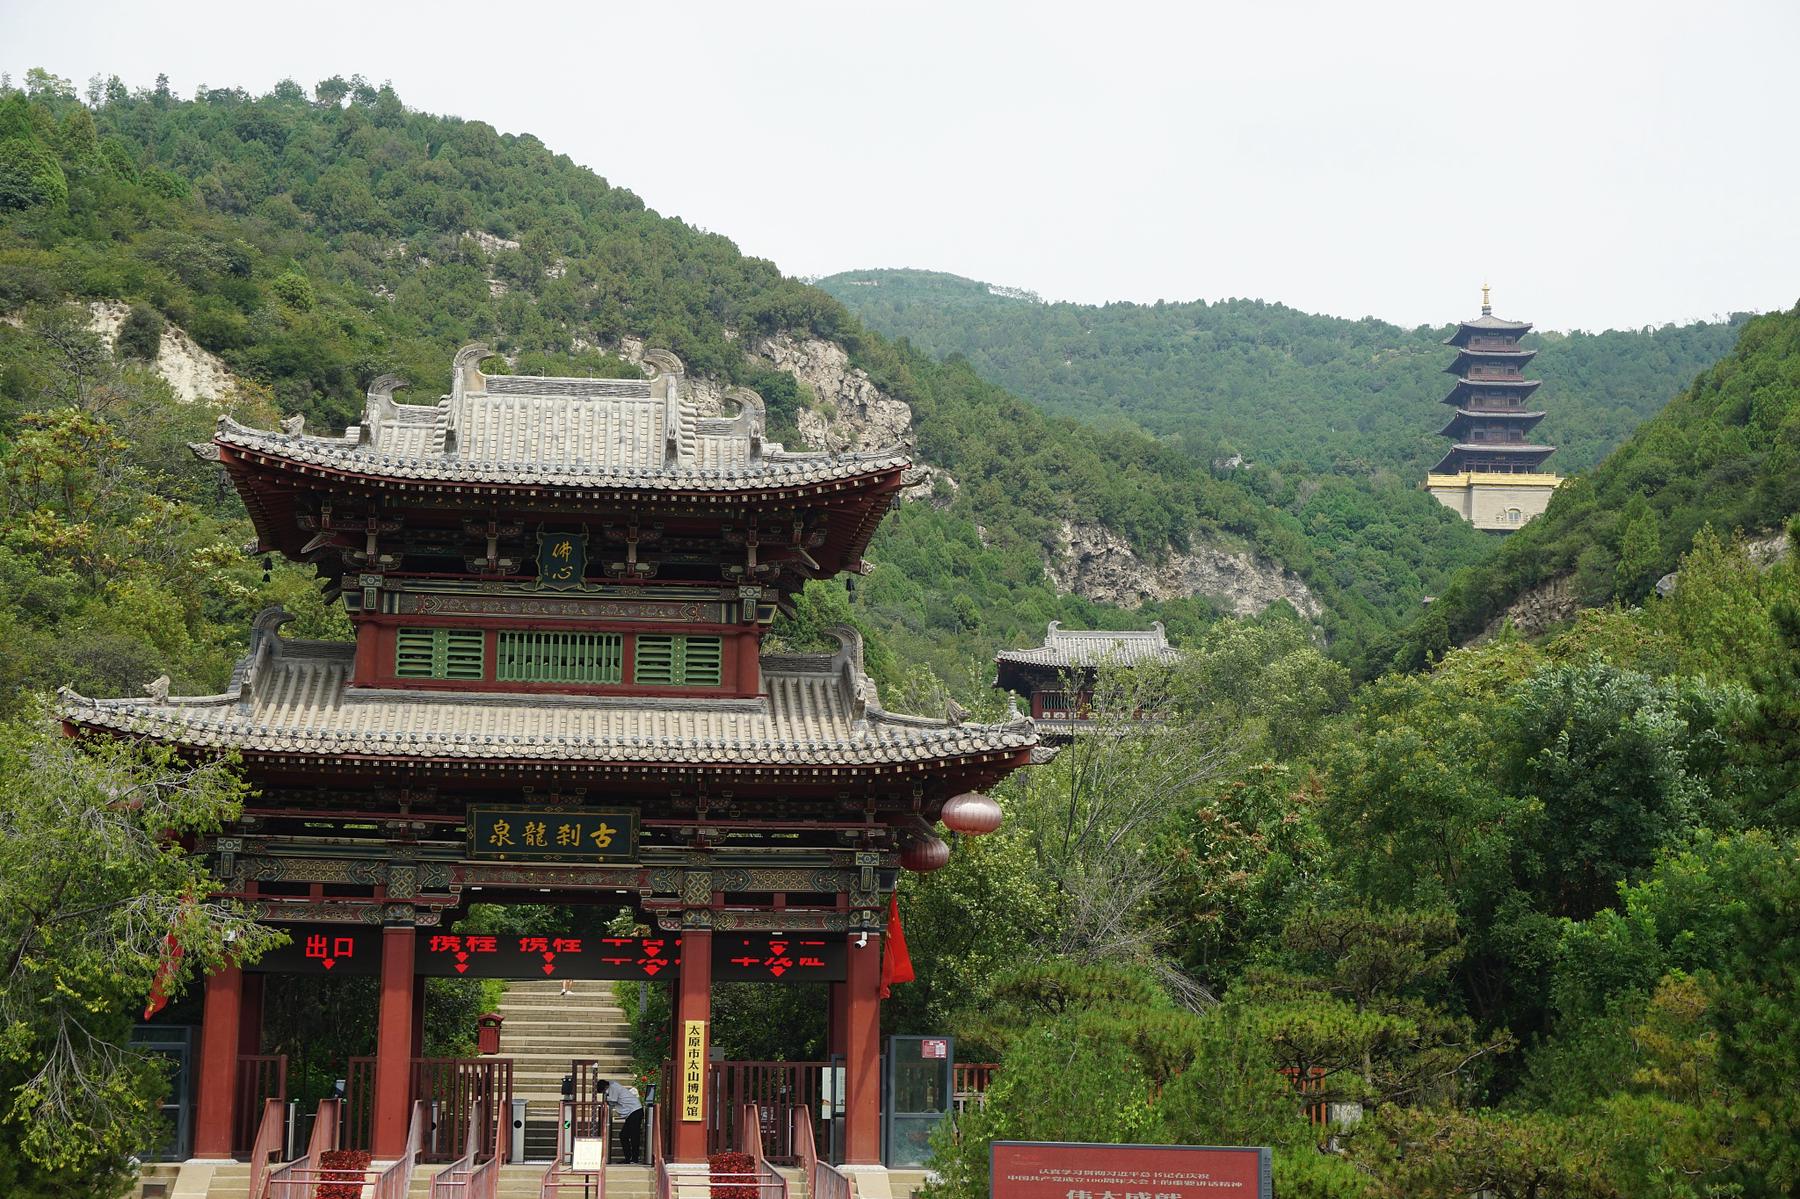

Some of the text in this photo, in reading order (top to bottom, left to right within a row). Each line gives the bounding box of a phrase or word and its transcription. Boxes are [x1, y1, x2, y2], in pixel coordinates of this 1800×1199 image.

[305, 934, 354, 958] 出口
[687, 1025, 700, 1117] 太原市太山博物馆
